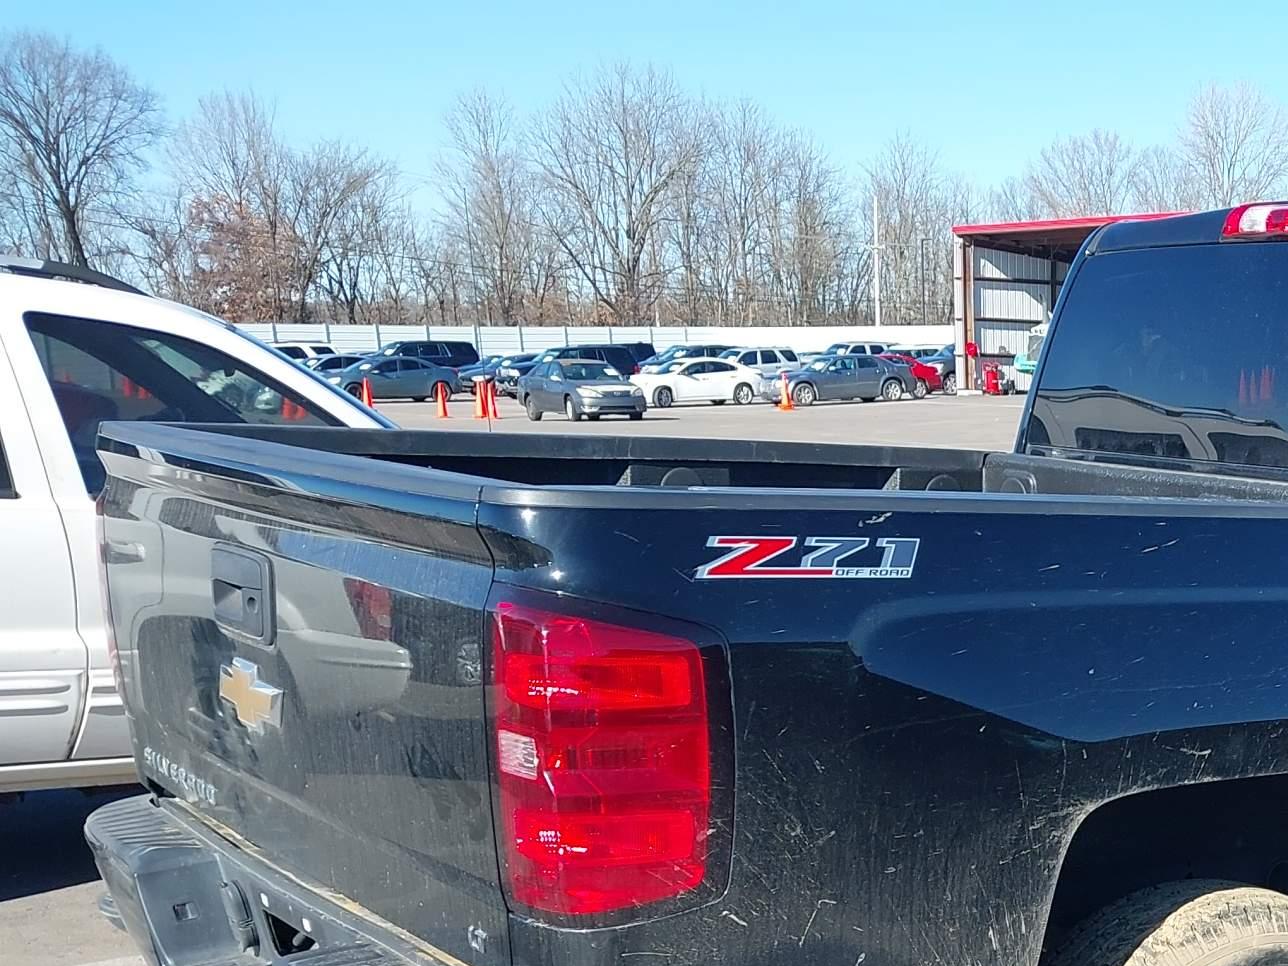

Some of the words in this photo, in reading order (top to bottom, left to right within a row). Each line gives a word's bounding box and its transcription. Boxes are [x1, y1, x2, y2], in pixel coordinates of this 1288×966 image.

[695, 535, 921, 579] Z71
[834, 568, 866, 577] OFF
[868, 568, 910, 577] ROAD
